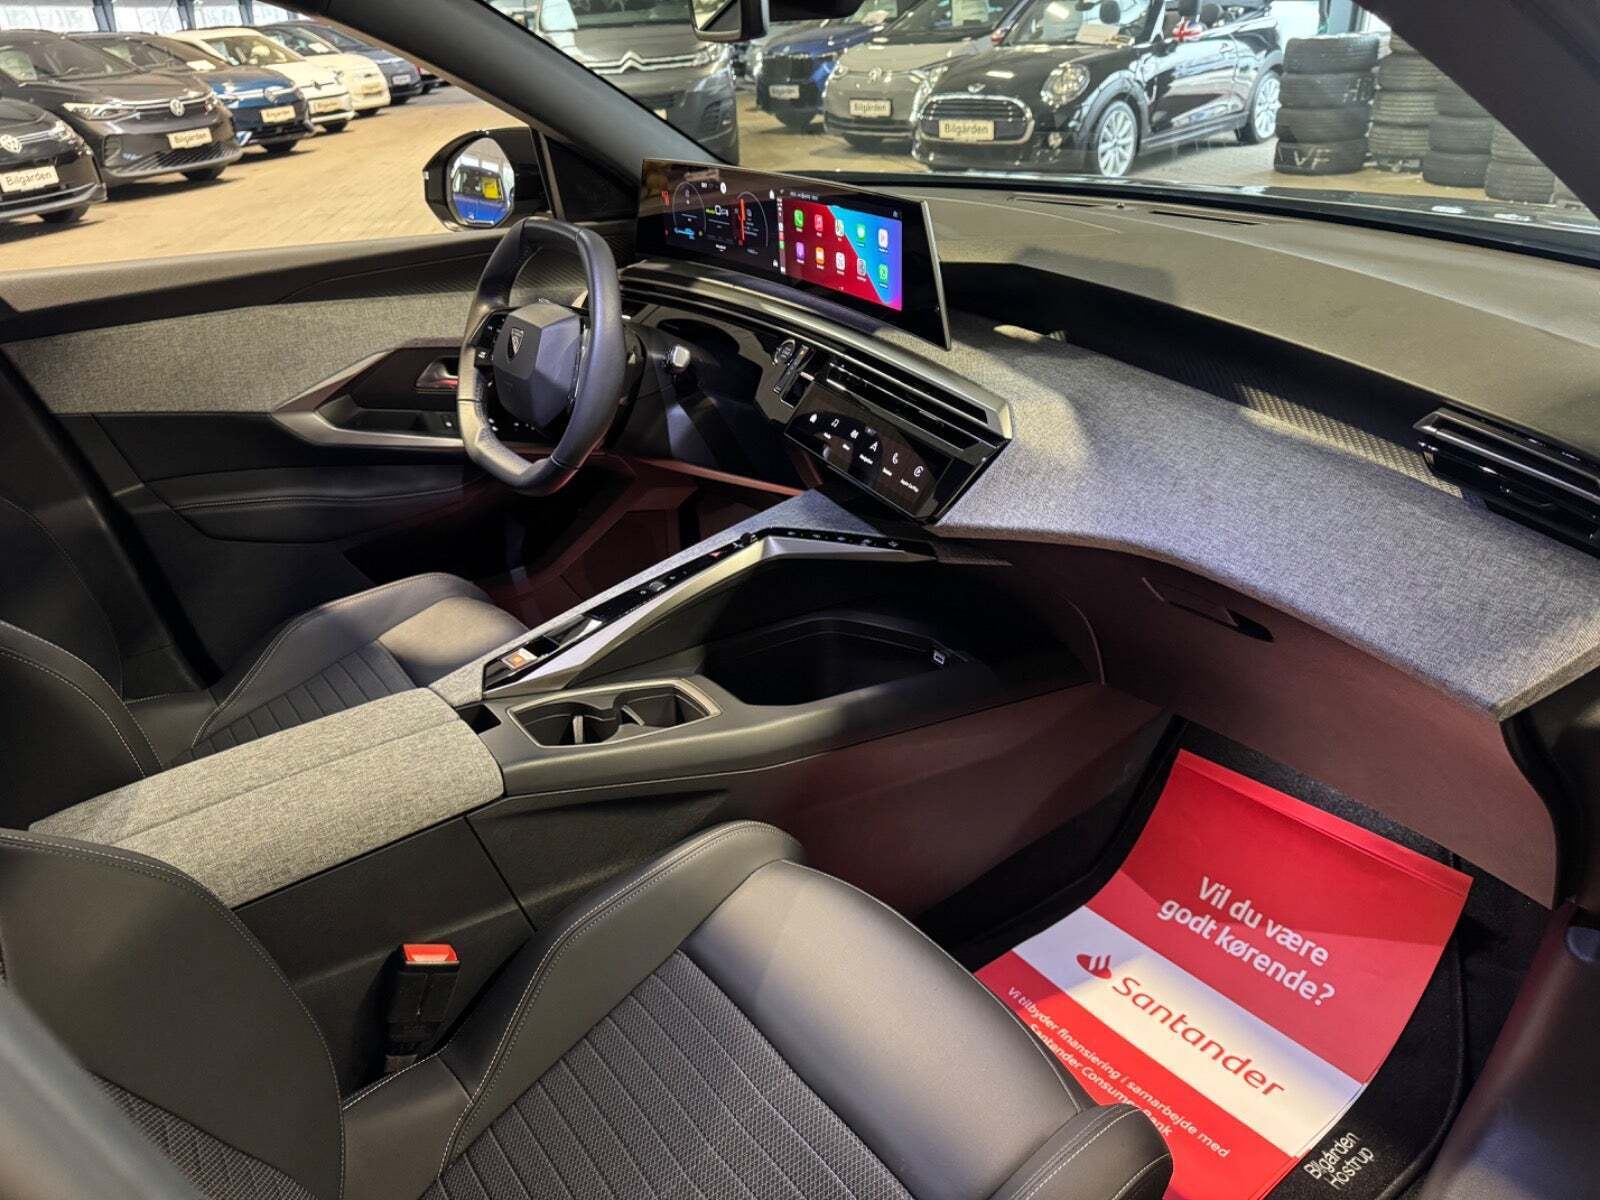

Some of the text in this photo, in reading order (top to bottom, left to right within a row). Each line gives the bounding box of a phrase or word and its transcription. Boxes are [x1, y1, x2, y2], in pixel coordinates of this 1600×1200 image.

[943, 123, 989, 137] Bilgården
[5, 169, 53, 187] Bilgården
[1156, 899, 1336, 1007] godt kørende?
[1199, 876, 1330, 967] Vil du være
[1111, 976, 1285, 1097] Santander
[1007, 986, 1022, 999] Vi
[1019, 996, 1060, 1031] tilbyder
[1056, 1028, 1122, 1080] finansiering
[1126, 1079, 1198, 1136] samarbejde
[1197, 1132, 1232, 1159] med
[1080, 1066, 1140, 1109] Consum
[1322, 1146, 1375, 1190] Hostrup
